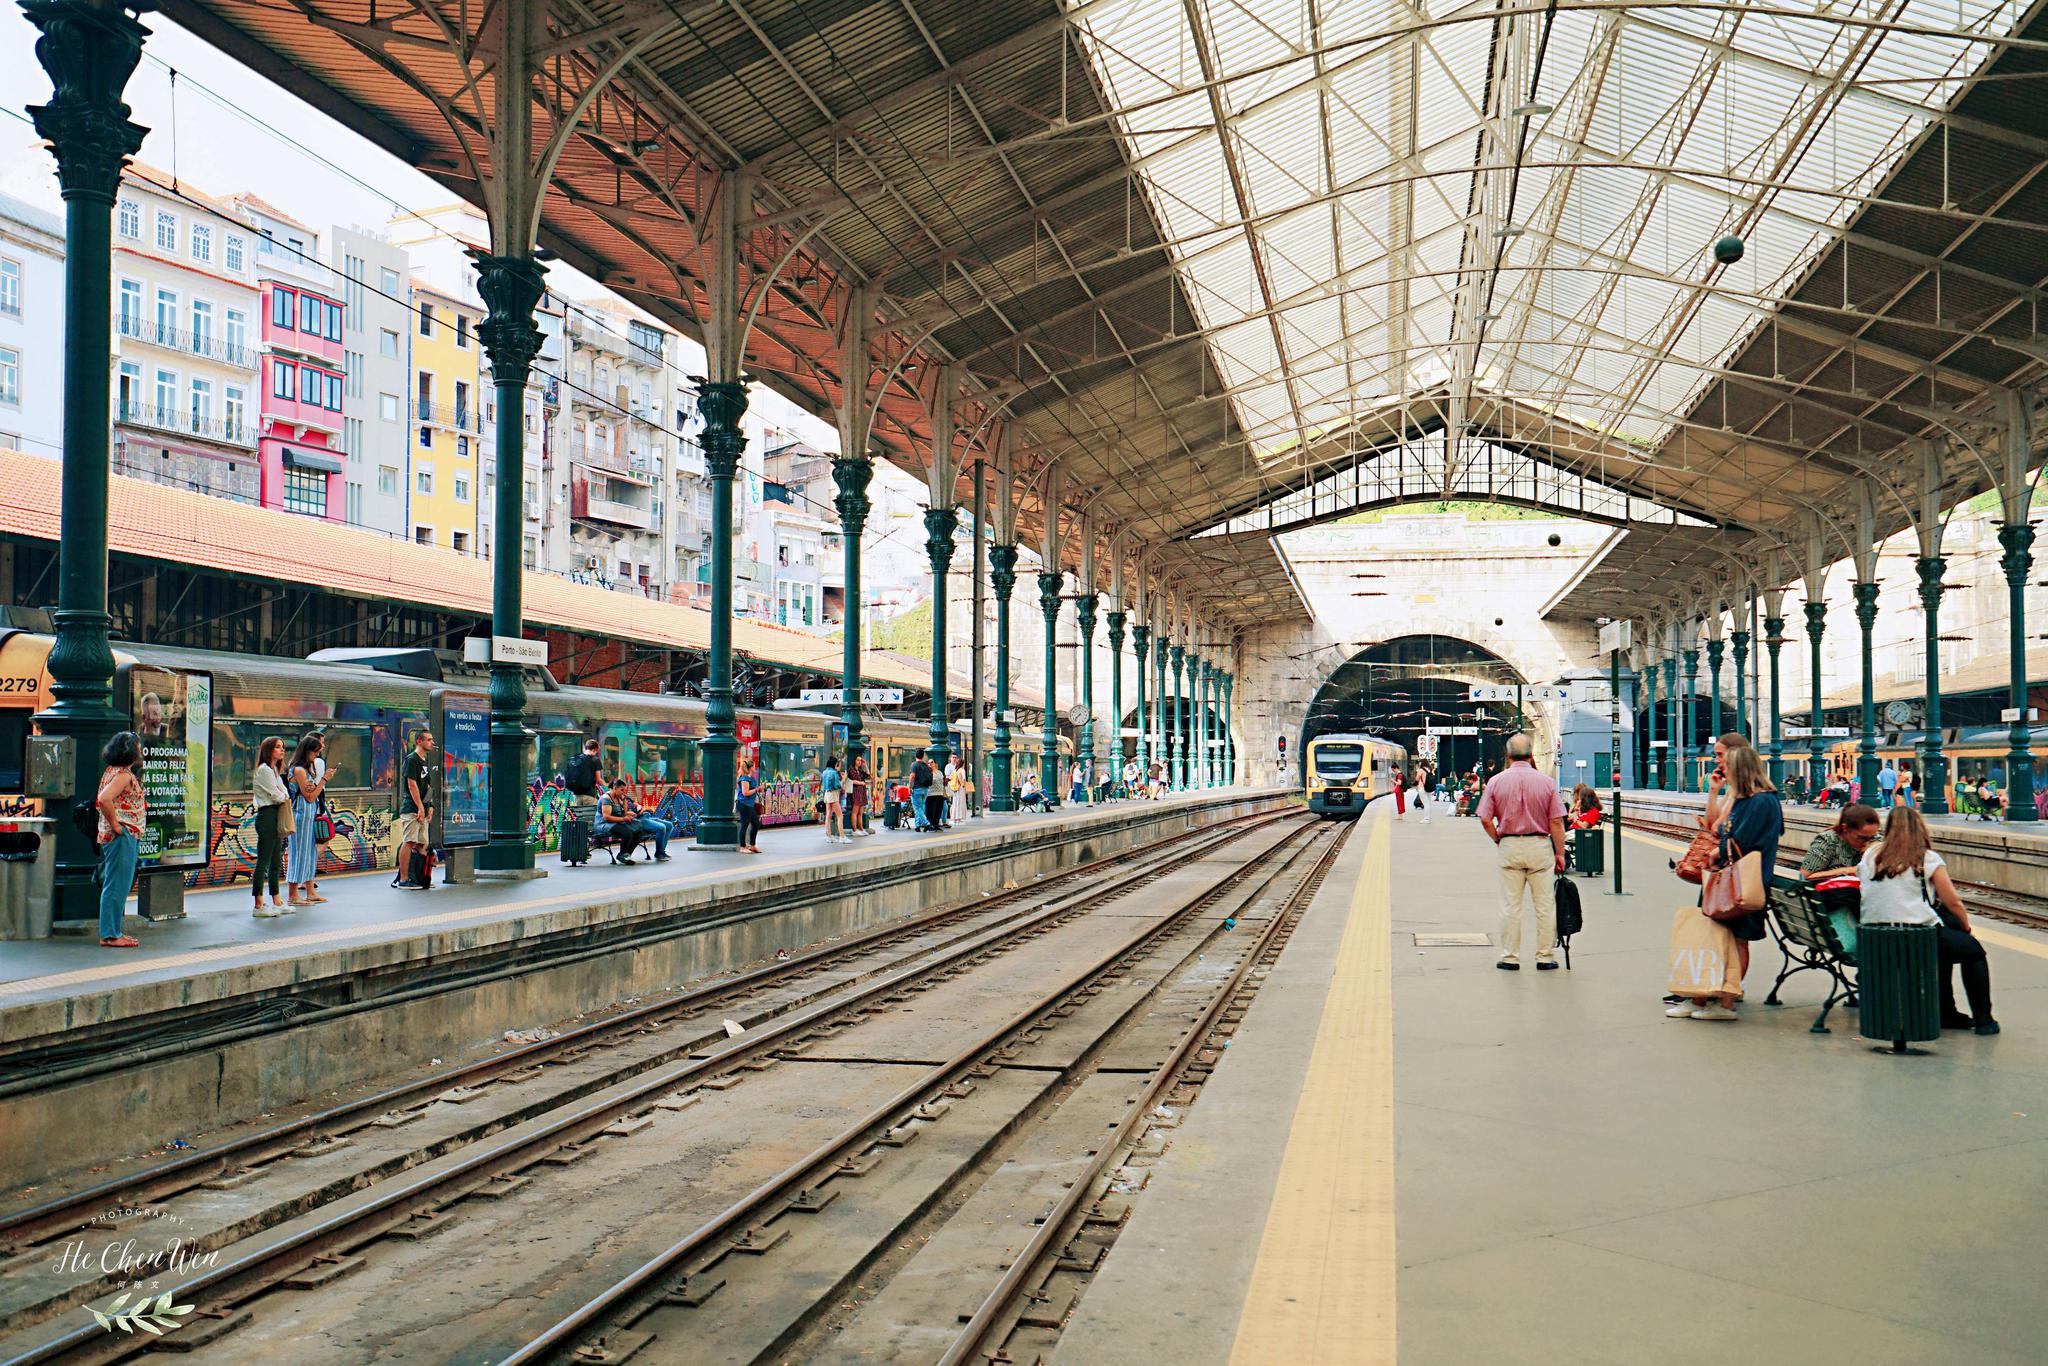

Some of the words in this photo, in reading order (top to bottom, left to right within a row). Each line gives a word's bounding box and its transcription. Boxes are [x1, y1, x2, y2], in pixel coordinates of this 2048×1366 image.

[502, 644, 515, 655] Porto
[519, 646, 527, 656] São
[528, 648, 542, 658] Bento
[0, 678, 37, 692] 279
[142, 747, 149, 756] O
[150, 747, 188, 758] PROGRAMA
[142, 760, 168, 770] BAIRRO
[169, 761, 186, 770] FELIZ
[151, 771, 168, 783] ESTÁ
[169, 773, 179, 783] EM
[139, 844, 159, 854] 1000€
